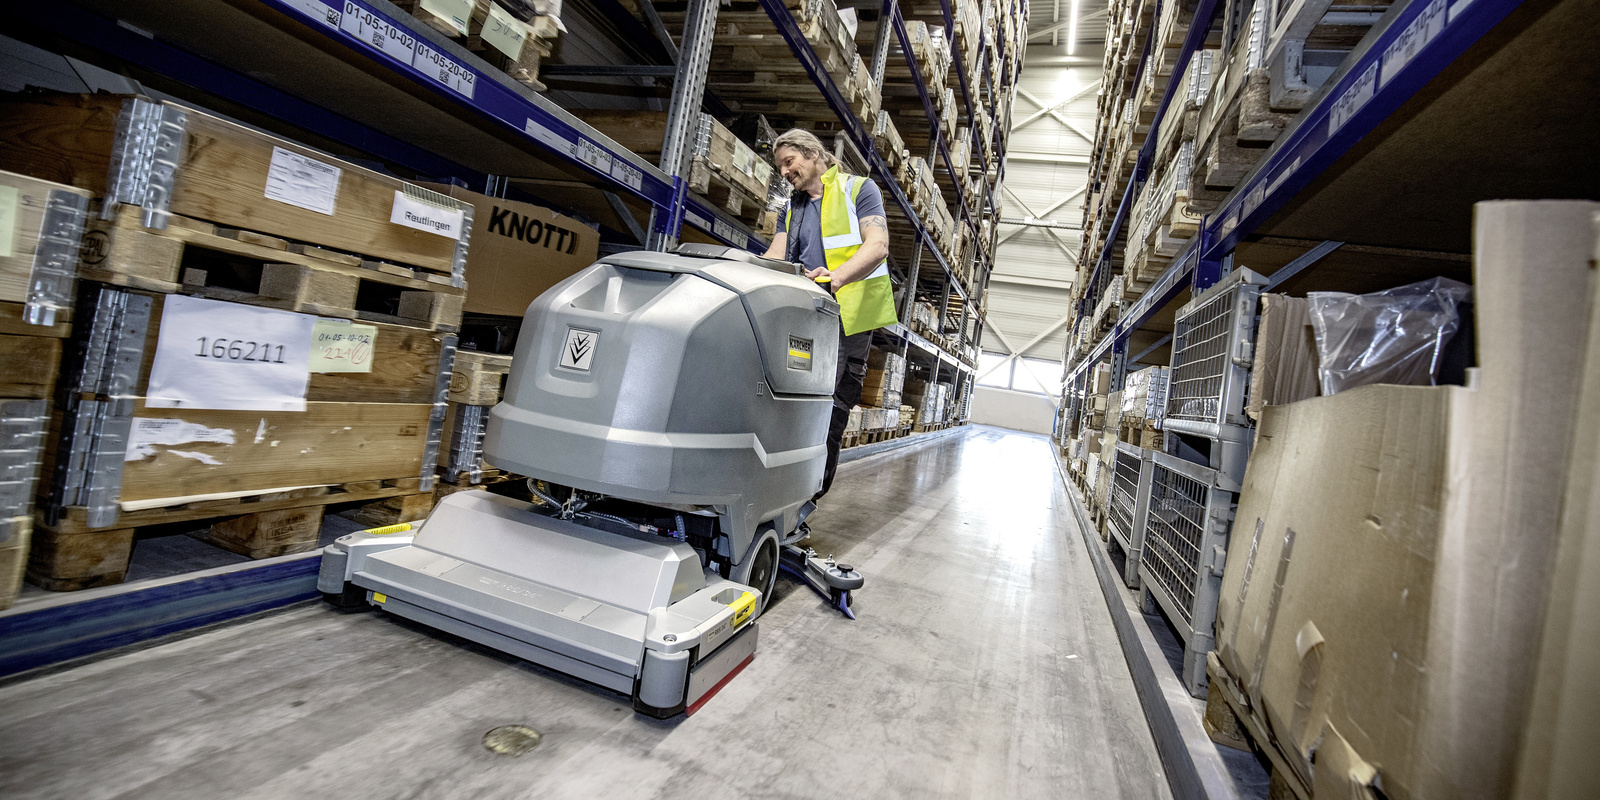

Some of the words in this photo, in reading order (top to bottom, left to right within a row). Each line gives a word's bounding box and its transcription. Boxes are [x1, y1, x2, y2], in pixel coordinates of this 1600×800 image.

[345, 2, 413, 50] 01-05-10-02
[417, 44, 473, 85] 01-05-20-02
[404, 210, 451, 231] Reutlingen
[194, 336, 287, 364] 166211
[271, 525, 294, 537] IKEA
